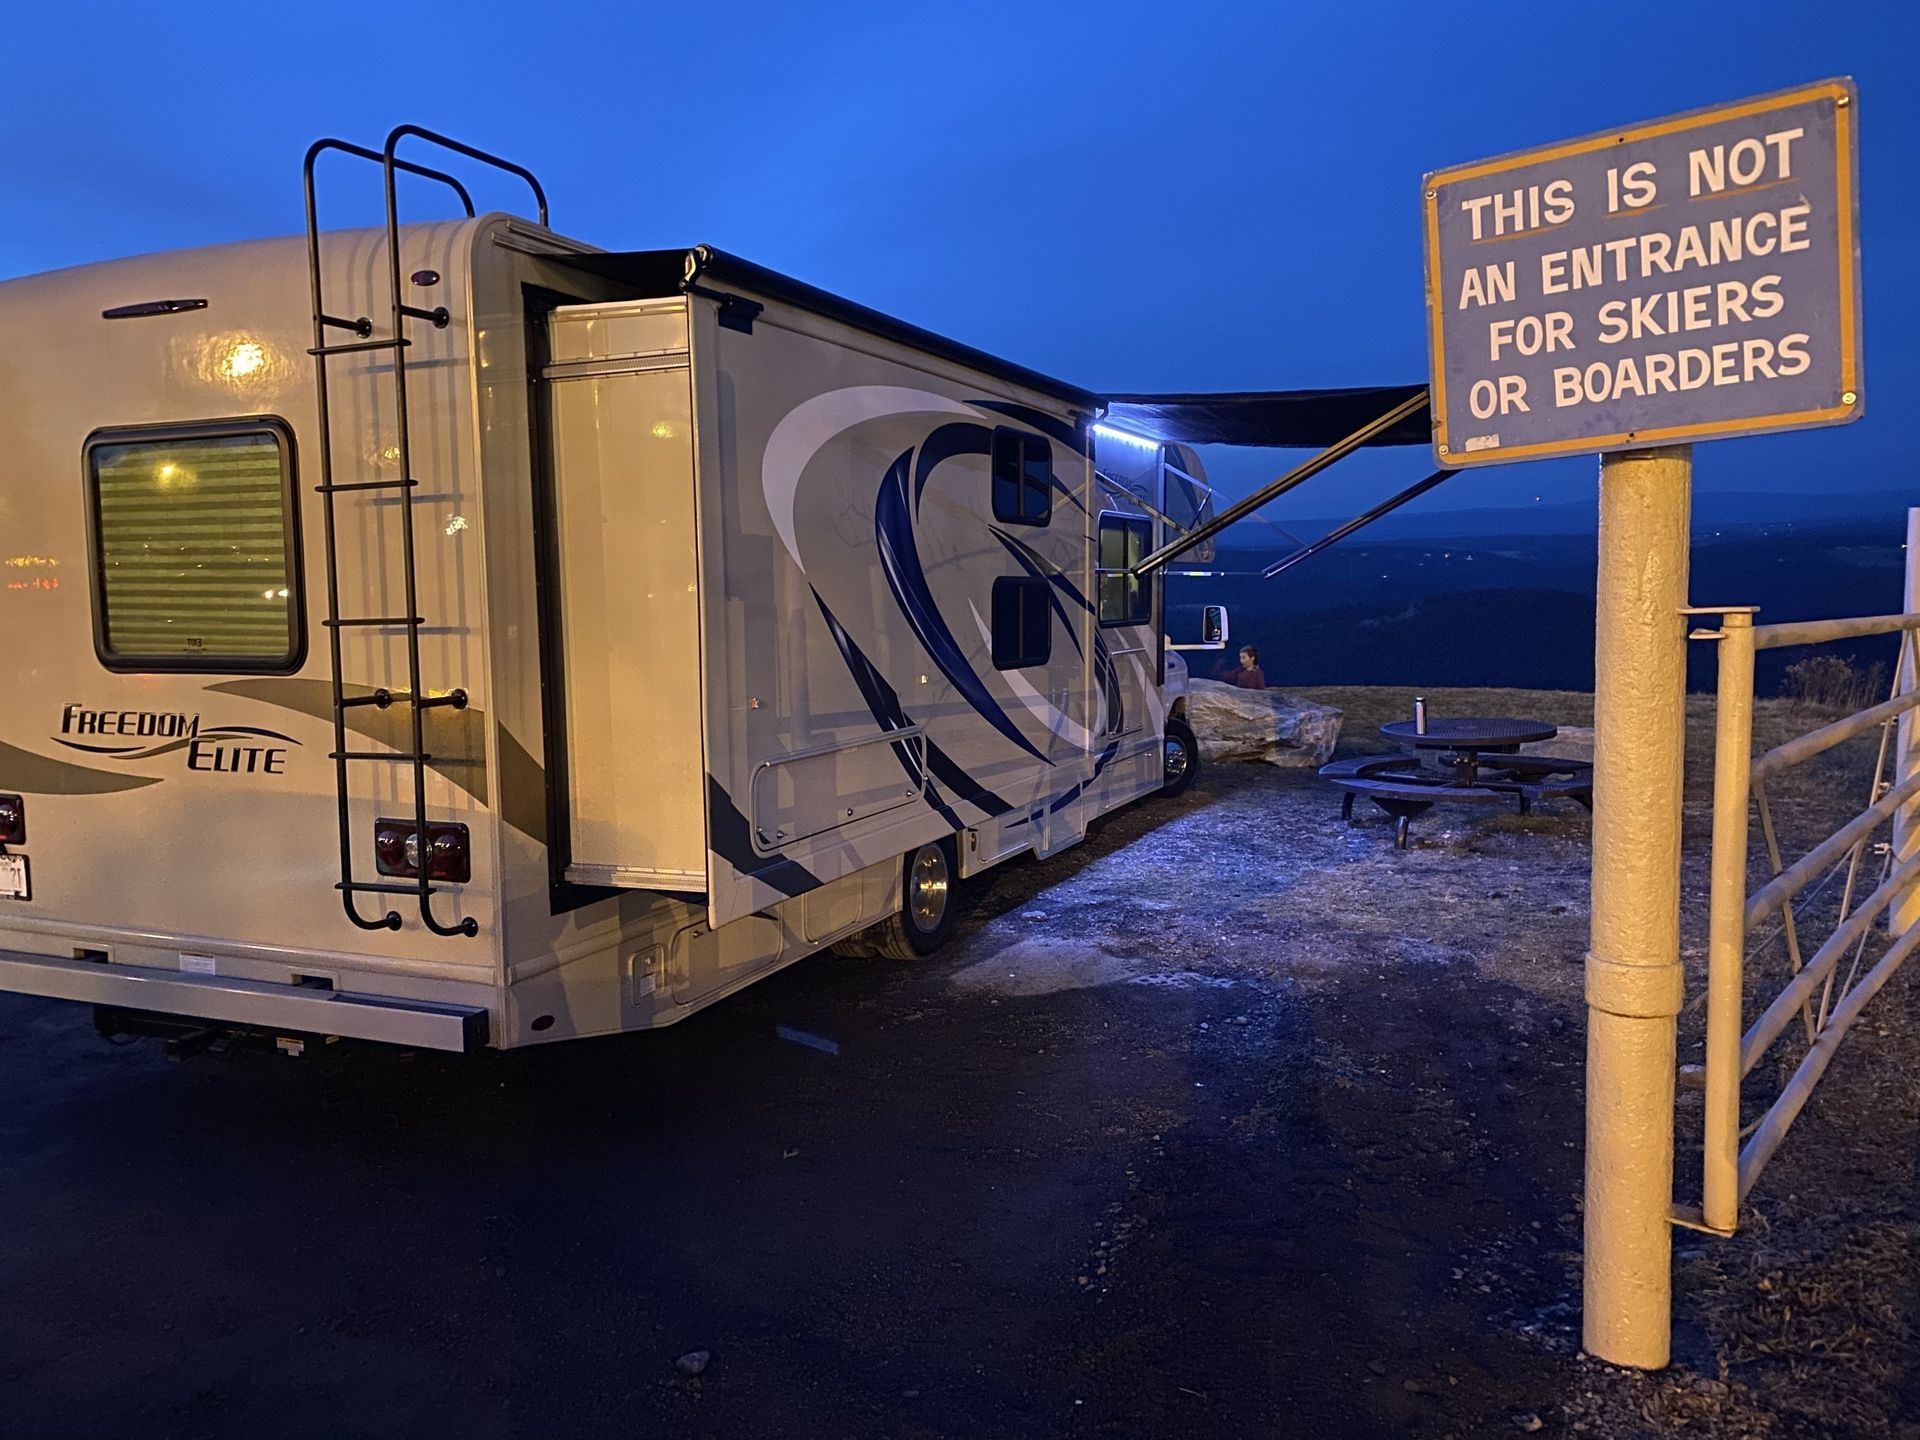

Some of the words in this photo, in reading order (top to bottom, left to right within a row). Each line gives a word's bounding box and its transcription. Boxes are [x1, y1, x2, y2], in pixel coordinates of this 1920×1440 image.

[1462, 180, 1575, 240] THIS
[1607, 162, 1657, 213] IS
[1688, 128, 1804, 196] NOT
[1458, 262, 1516, 310] AN
[1541, 206, 1812, 295] ENTRANCE
[1489, 311, 1575, 361] FOR
[1598, 274, 1785, 344] SKIERS
[1469, 375, 1531, 419] OR
[1553, 333, 1812, 407] BOARDERS
[62, 703, 199, 738] FREEDOM
[187, 738, 287, 775] ELITE
